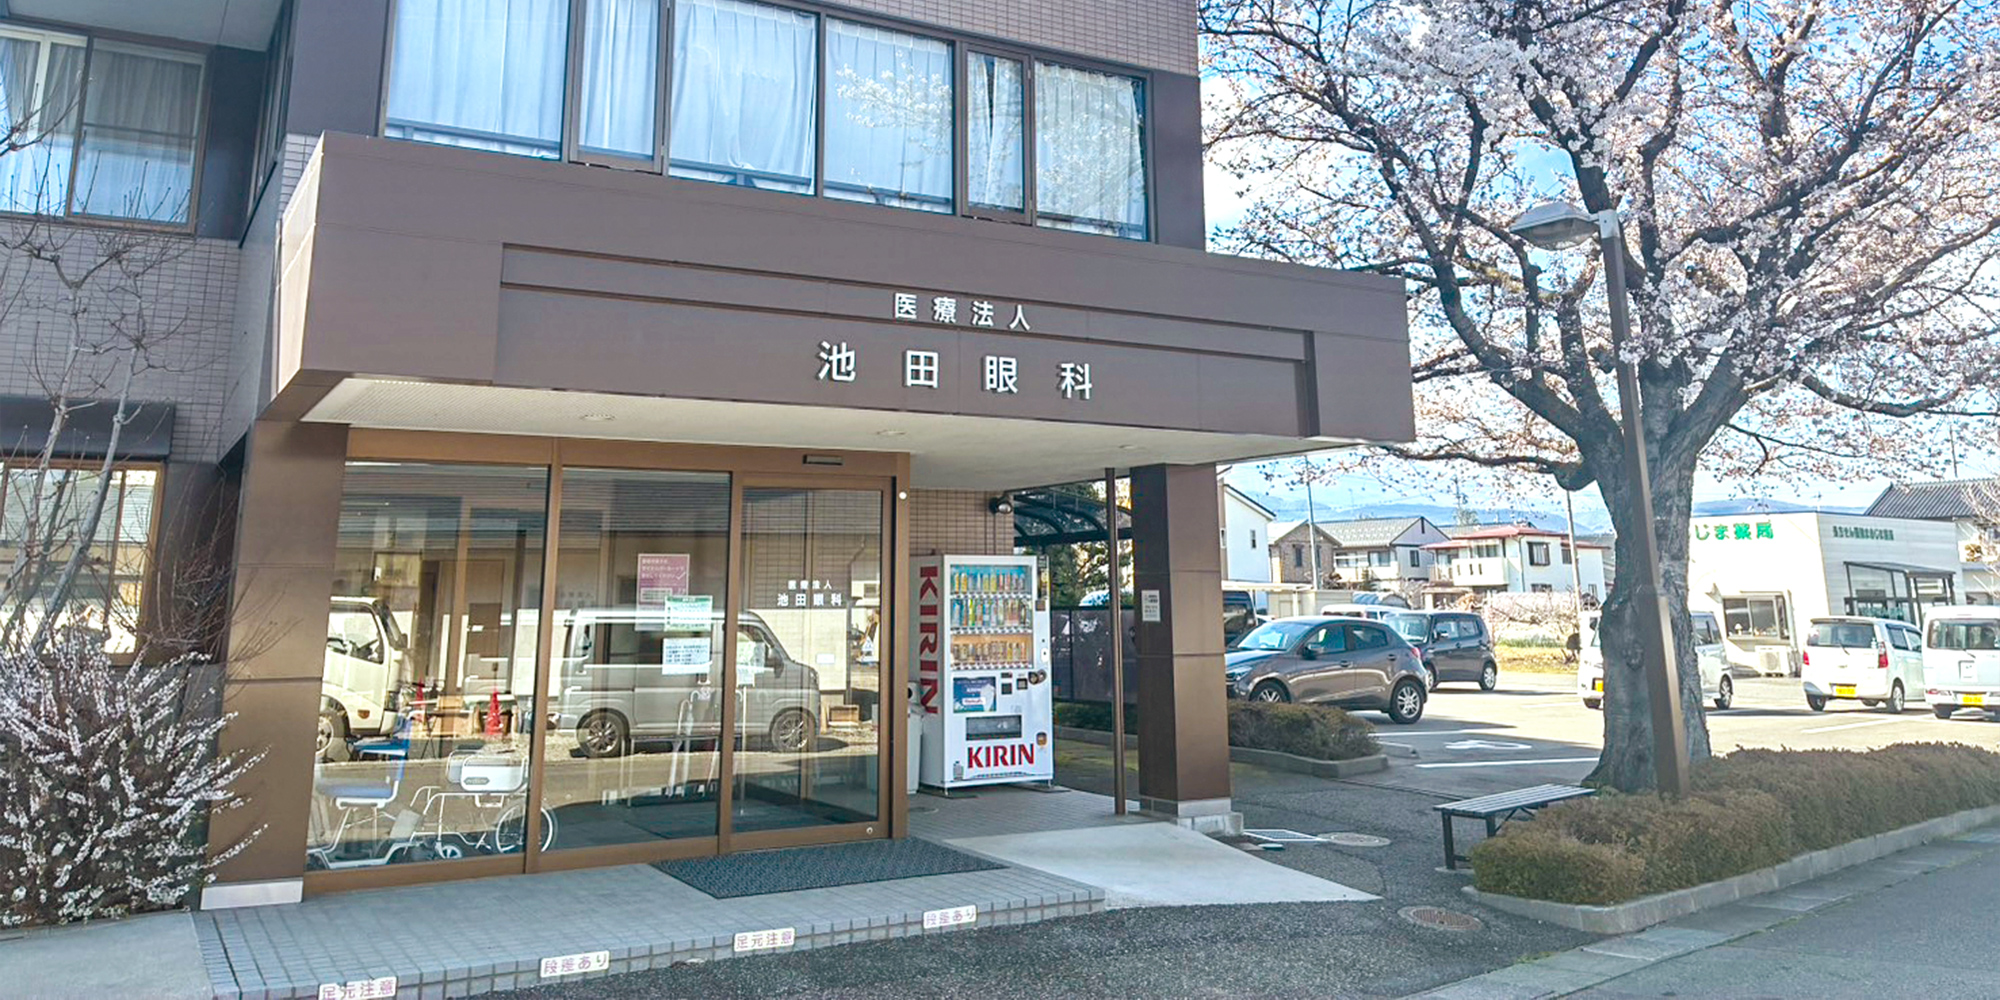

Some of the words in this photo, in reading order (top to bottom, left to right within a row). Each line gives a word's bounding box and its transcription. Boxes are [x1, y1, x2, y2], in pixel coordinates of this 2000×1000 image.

[894, 292, 1031, 331] 医療法人
[818, 341, 1093, 400] 池田眼科
[920, 566, 938, 714] KIRIN
[968, 743, 1034, 769] KIRIN
[926, 908, 976, 927] 段差あり
[736, 929, 793, 950] 足元注意
[543, 952, 608, 975] 段差あり
[322, 979, 395, 1000] 足元注意
